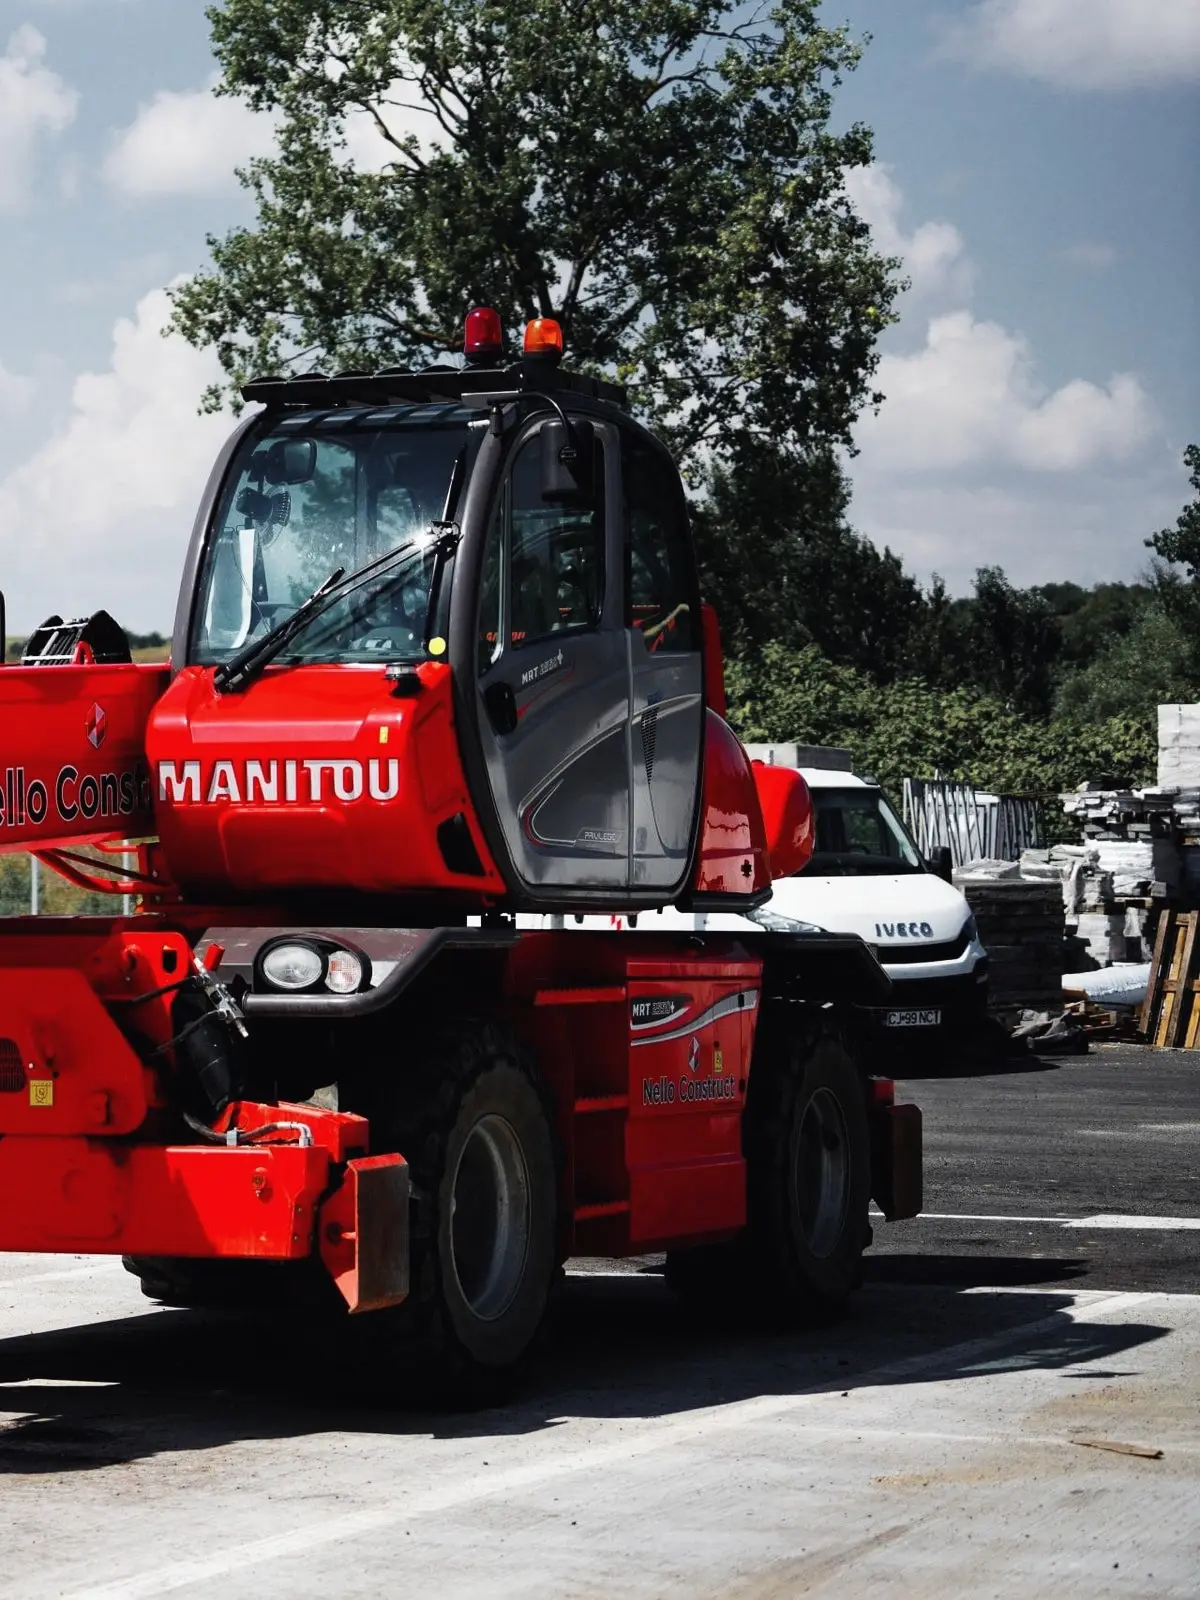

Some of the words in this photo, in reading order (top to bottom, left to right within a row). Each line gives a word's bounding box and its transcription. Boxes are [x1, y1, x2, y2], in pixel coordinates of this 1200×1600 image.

[521, 667, 539, 686] MRT
[158, 758, 399, 803] MANITOU
[874, 922, 934, 938] IVECO
[632, 1002, 651, 1017] MRT
[642, 1075, 675, 1106] Nello
[679, 1073, 735, 1102] Construct
